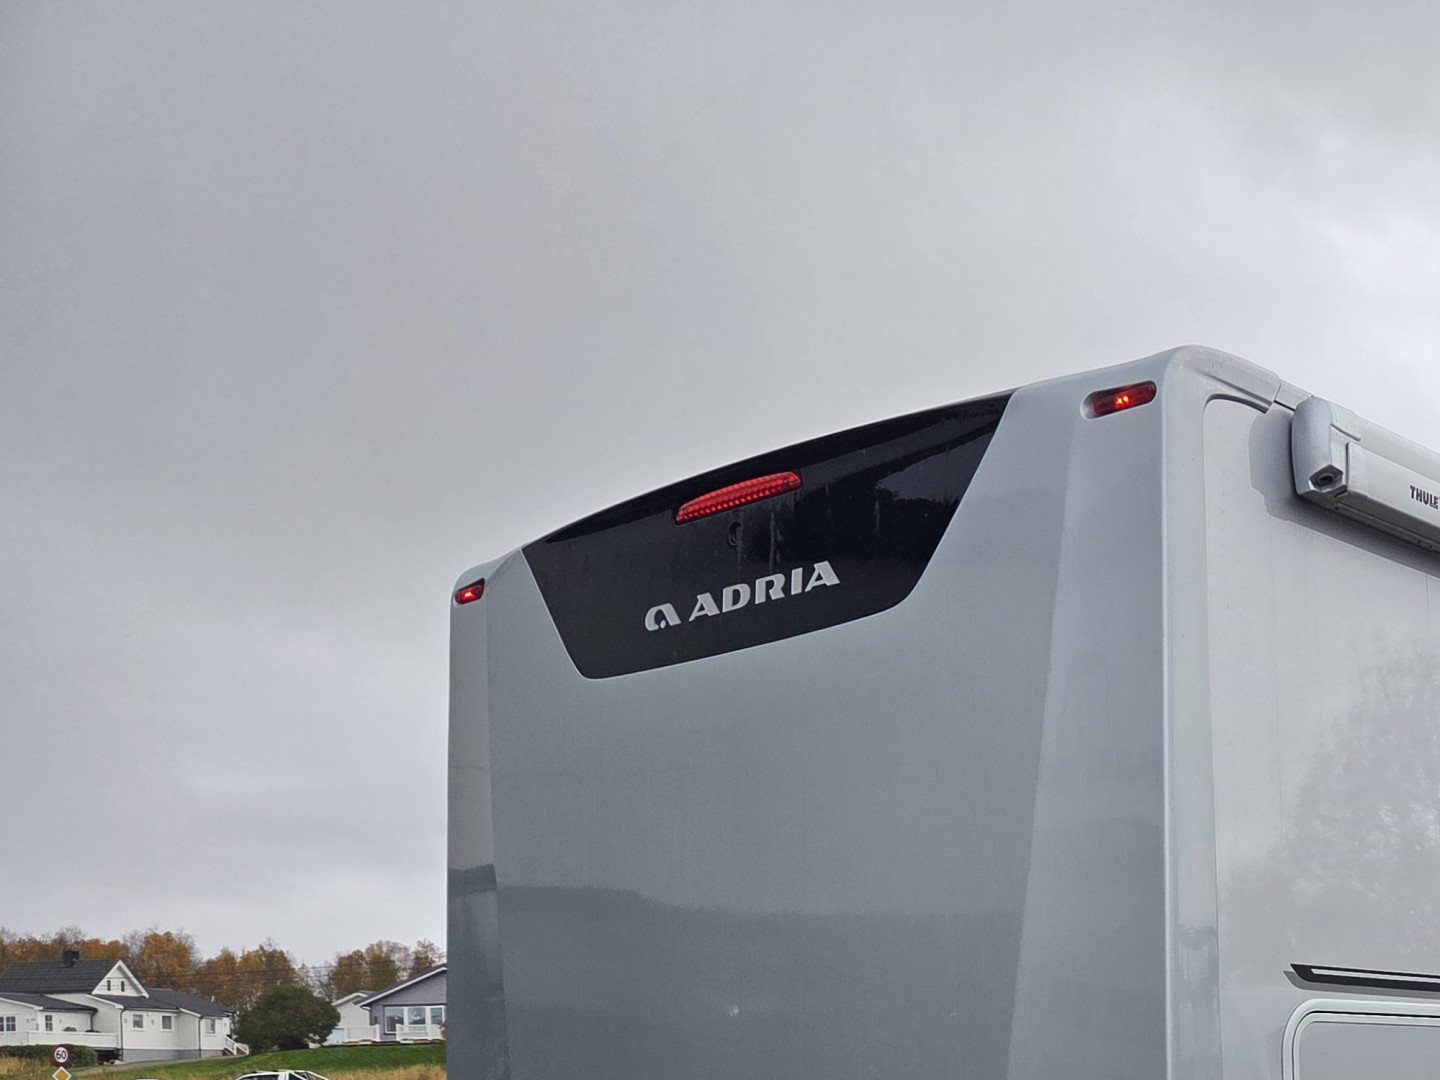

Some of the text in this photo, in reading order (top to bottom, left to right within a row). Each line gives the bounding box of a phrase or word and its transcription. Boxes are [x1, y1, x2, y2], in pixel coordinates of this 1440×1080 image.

[1409, 484, 1439, 510] THULE
[688, 560, 841, 622] ADRIA
[55, 1049, 67, 1060] 60
